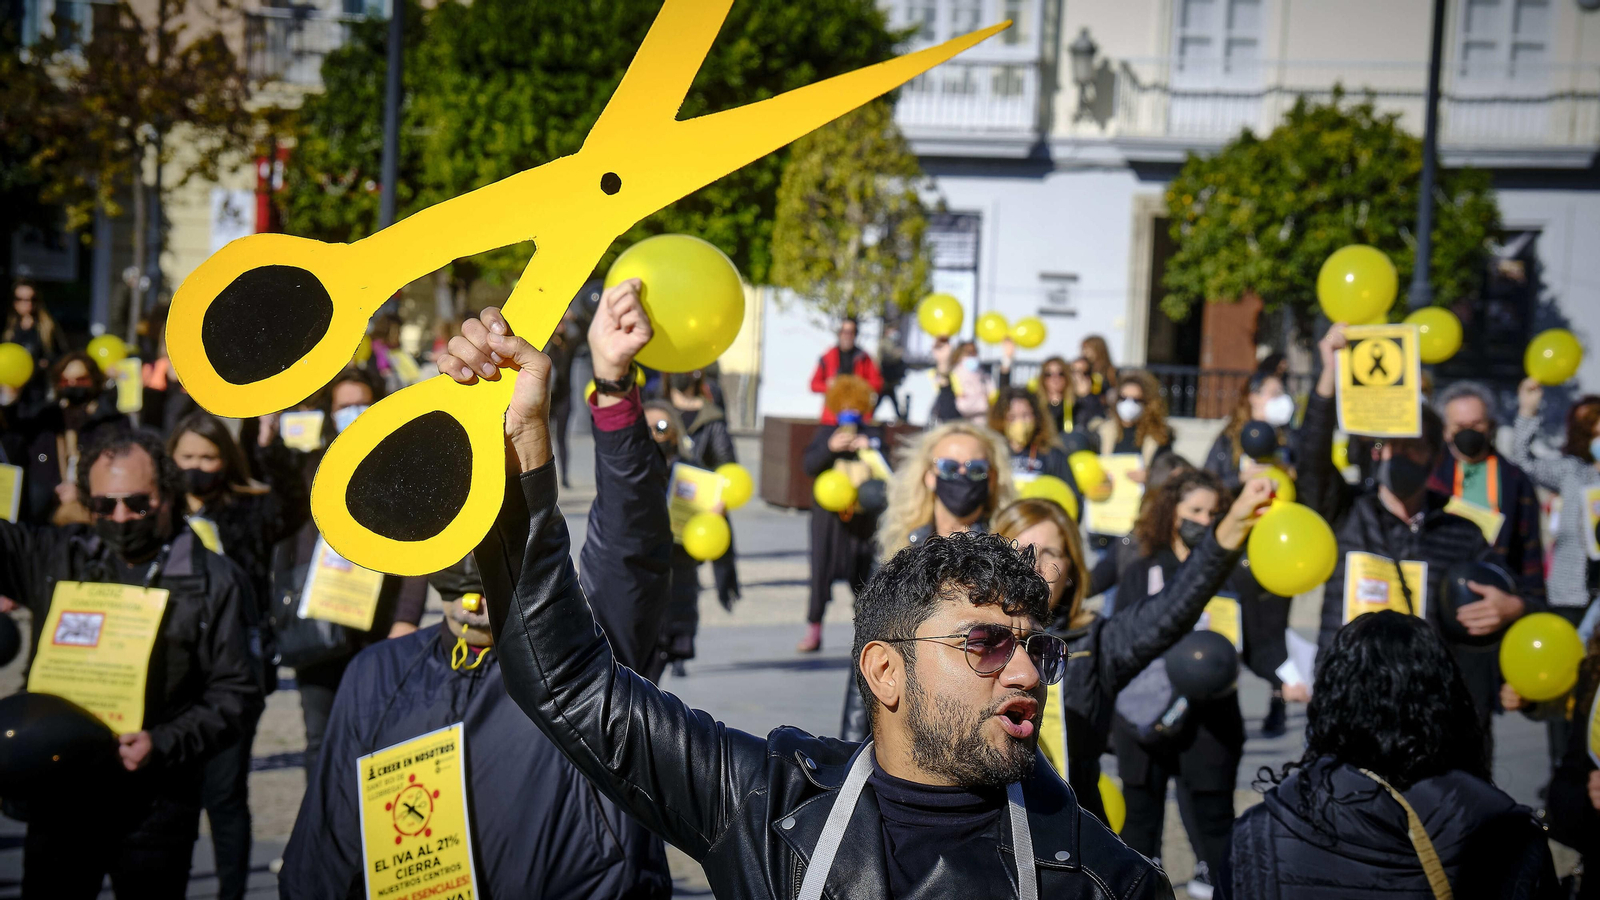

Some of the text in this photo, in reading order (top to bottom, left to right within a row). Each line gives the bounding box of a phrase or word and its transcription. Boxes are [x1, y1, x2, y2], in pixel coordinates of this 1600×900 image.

[378, 762, 401, 776] CREER
[404, 758, 412, 768] EN
[415, 742, 455, 763] NOSOTROS
[375, 834, 460, 873] EL IVA AL 21%
[395, 857, 441, 880] CIERRA
[378, 862, 462, 897] NUESTROS CENTROS
[412, 874, 471, 900] ESENCIALES!
